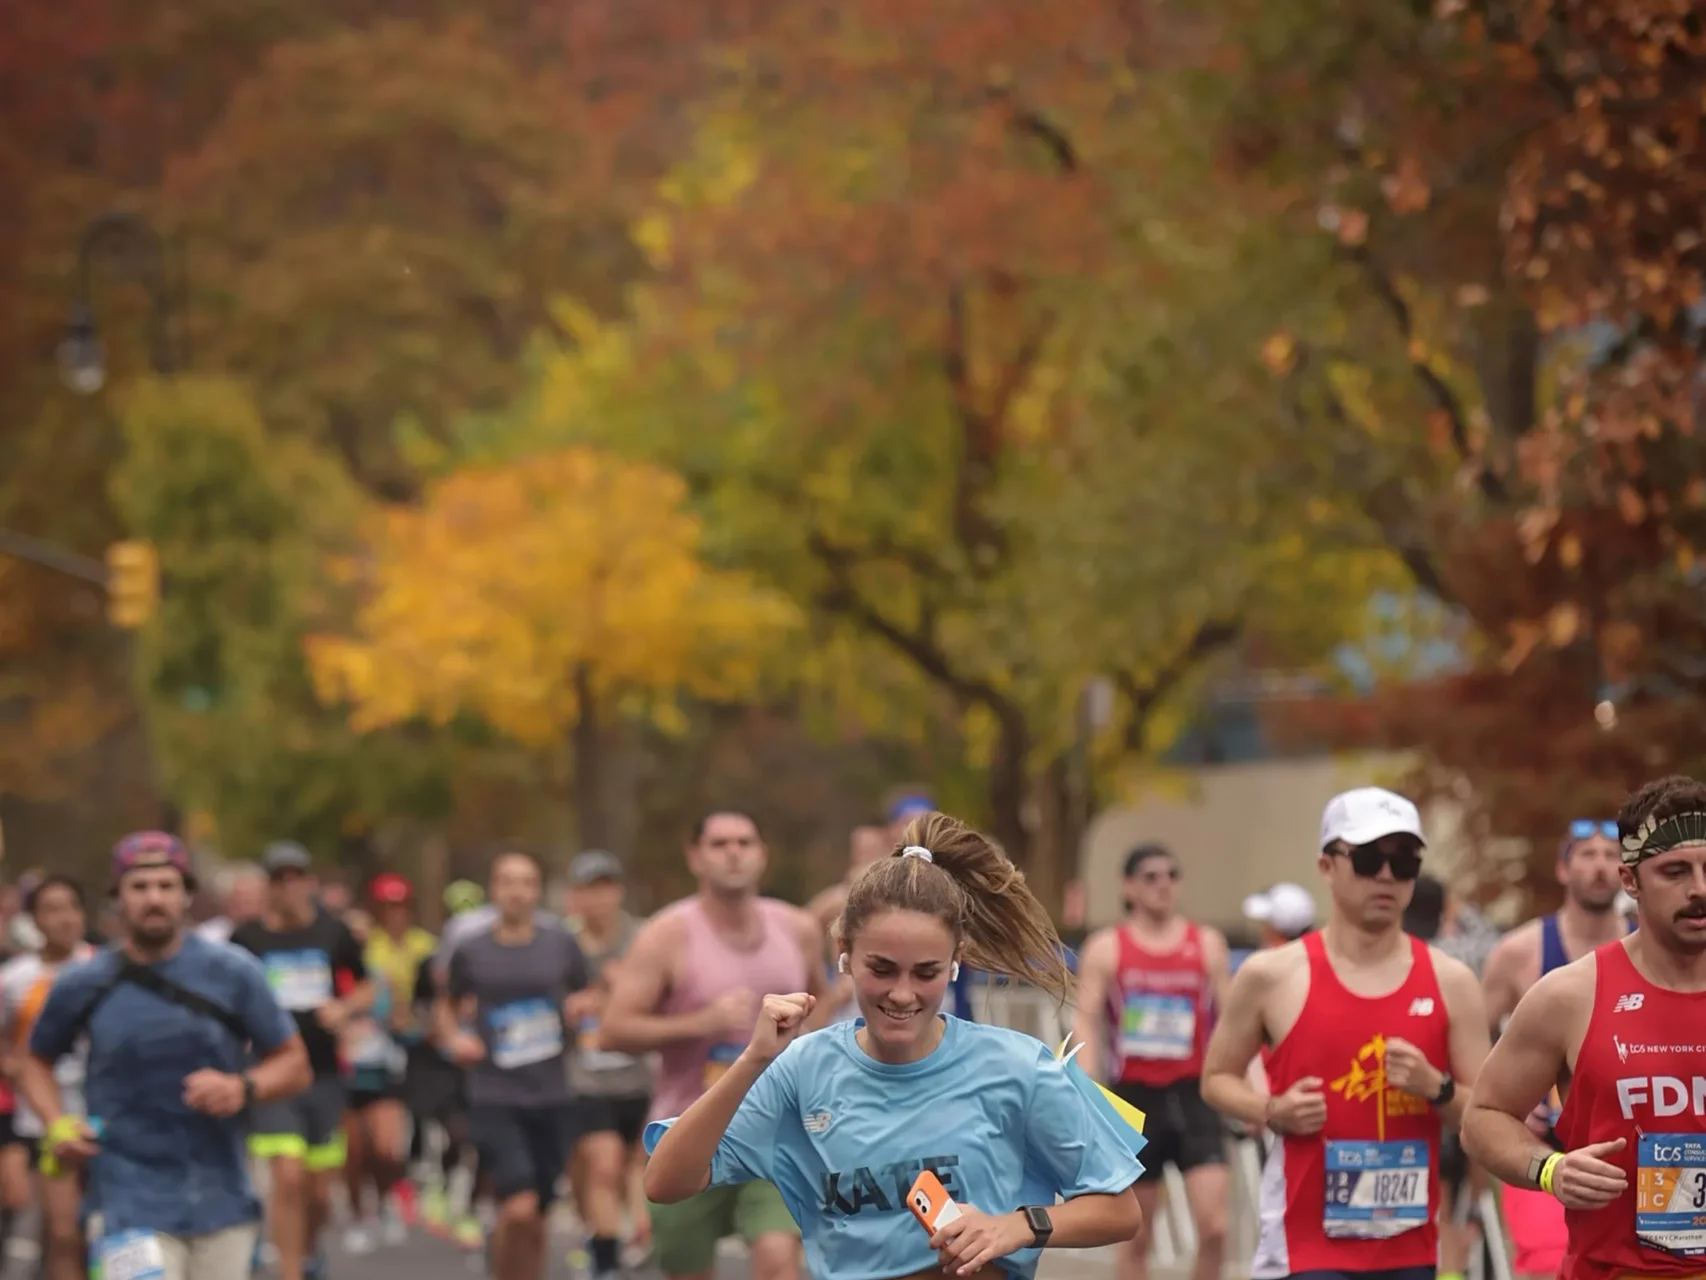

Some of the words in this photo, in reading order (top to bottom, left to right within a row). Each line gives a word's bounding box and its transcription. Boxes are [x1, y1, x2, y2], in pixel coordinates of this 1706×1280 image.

[1647, 1045, 1668, 1053] NEW
[1669, 1045, 1694, 1053] YORK
[1654, 1143, 1681, 1161] tcs
[820, 1155, 959, 1216] KATE
[1654, 1172, 1664, 1186] 3
[1374, 1172, 1419, 1204] 18247
[1653, 1194, 1665, 1207] C
